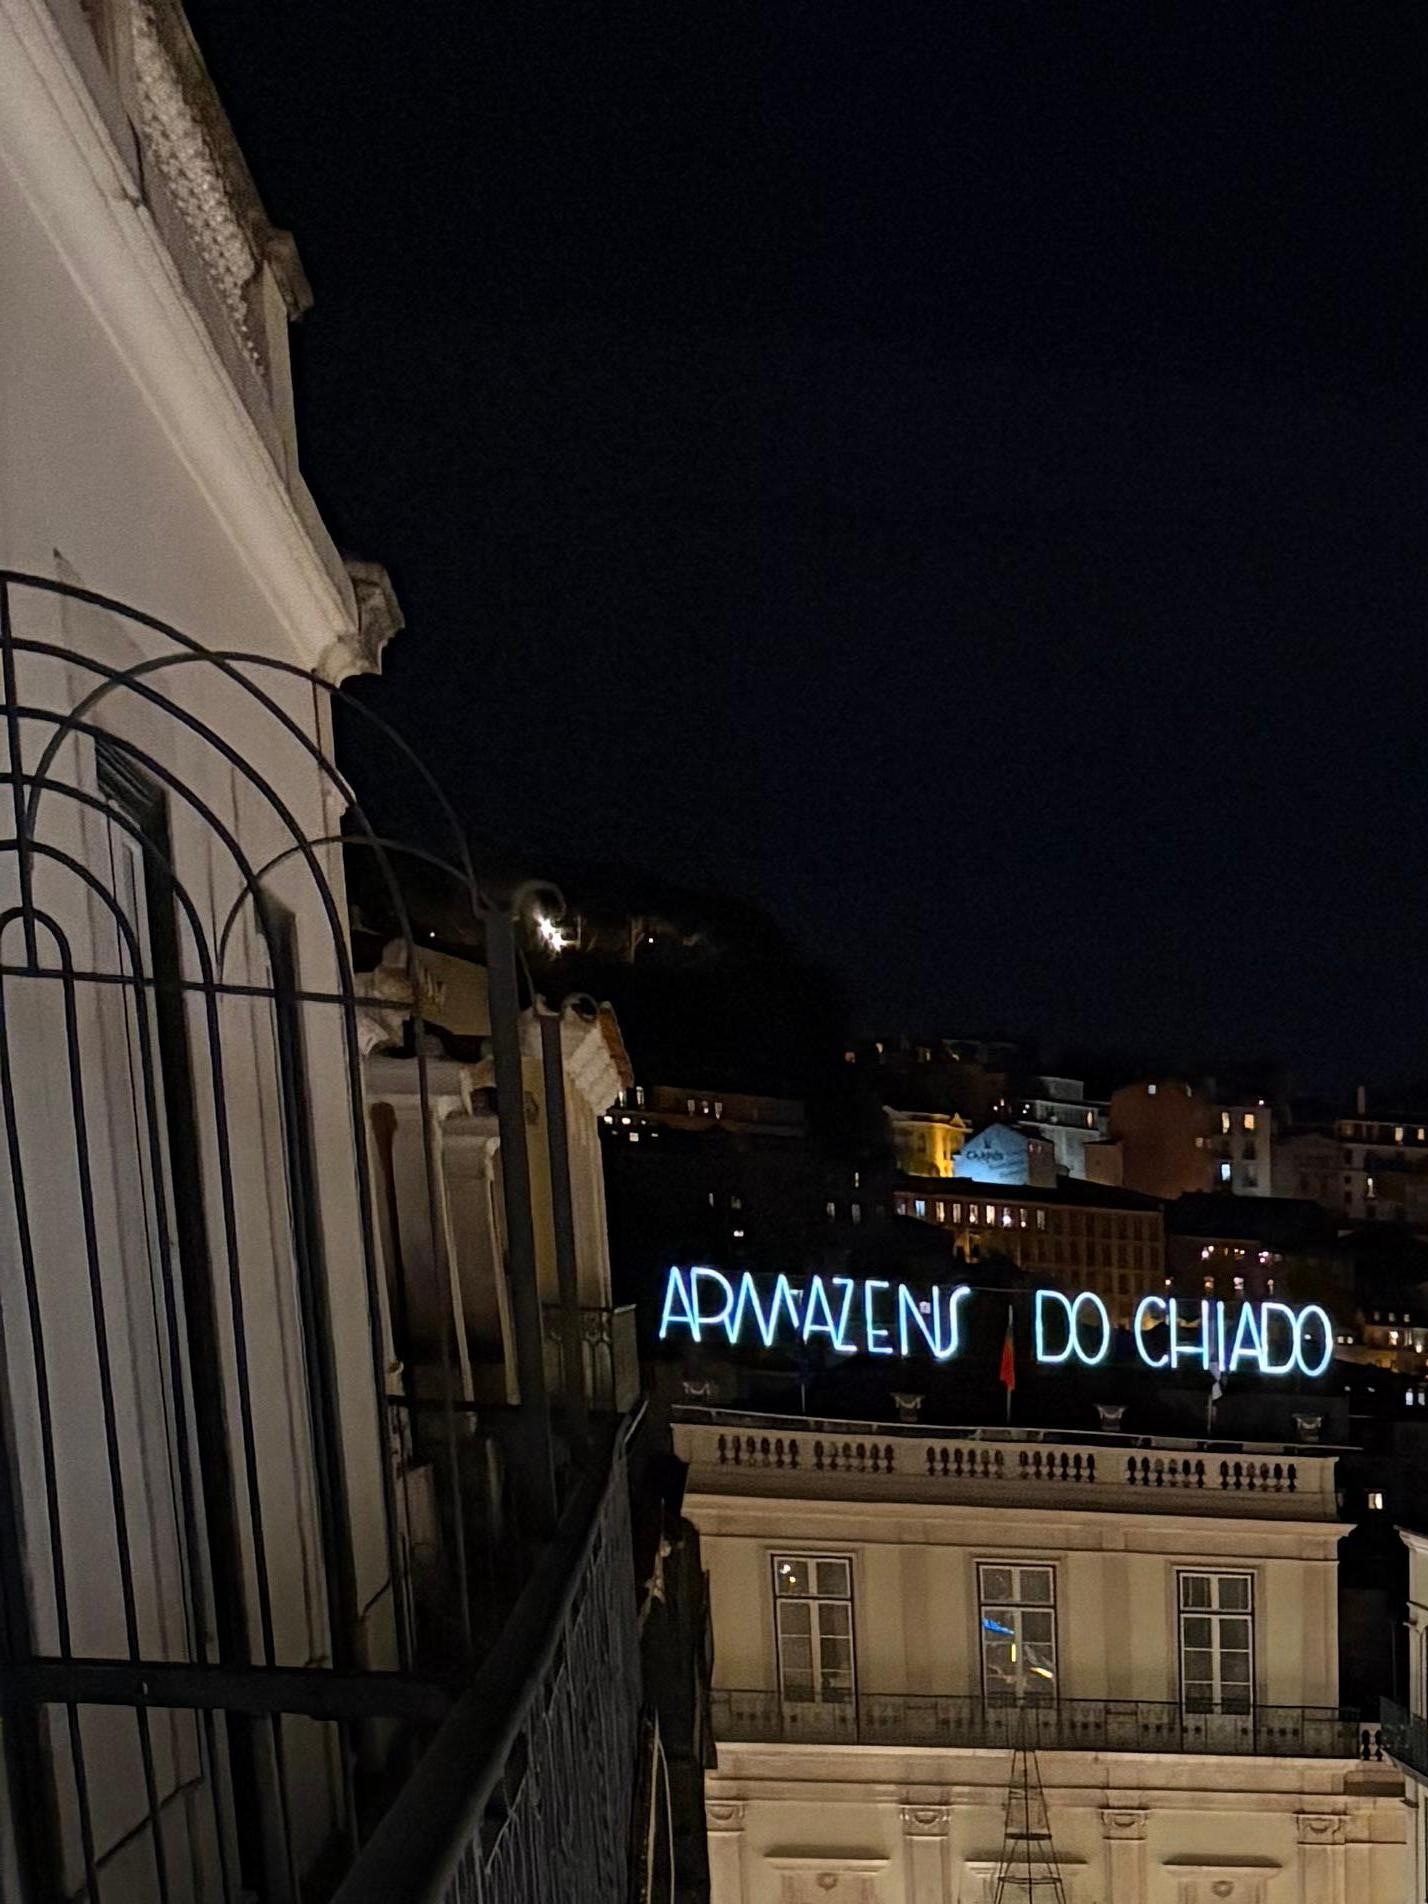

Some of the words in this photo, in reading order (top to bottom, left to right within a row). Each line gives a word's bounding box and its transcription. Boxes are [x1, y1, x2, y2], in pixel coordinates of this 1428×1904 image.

[659, 1264, 971, 1360] ARMAZENS
[1033, 1288, 1110, 1366] DO
[1133, 1294, 1333, 1377] CHIADO
